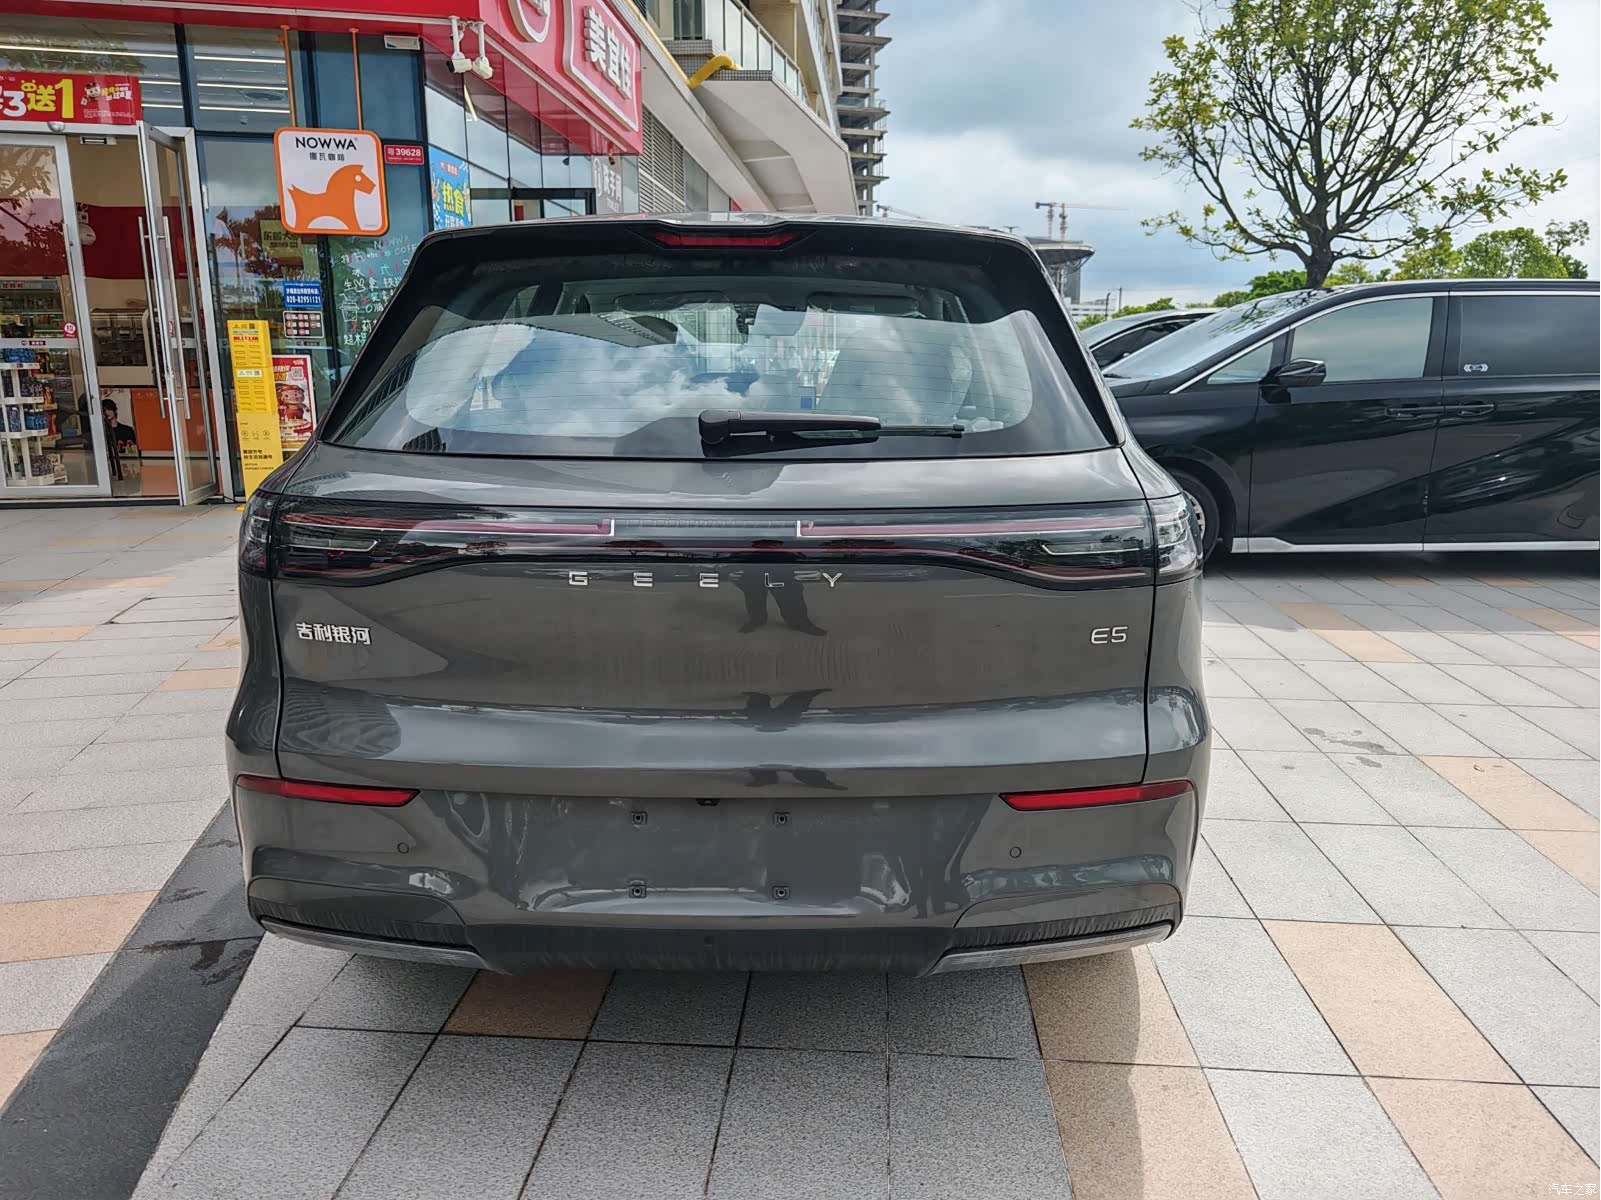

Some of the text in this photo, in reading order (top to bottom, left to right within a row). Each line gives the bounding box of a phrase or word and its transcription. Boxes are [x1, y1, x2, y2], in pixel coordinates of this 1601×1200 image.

[584, 5, 632, 100] 美宜佳
[0, 78, 74, 119] 3送1
[295, 136, 357, 151] NOWWA
[568, 570, 843, 588] GEELY
[295, 622, 371, 645] 吉利银河
[1090, 626, 1129, 645] E5
